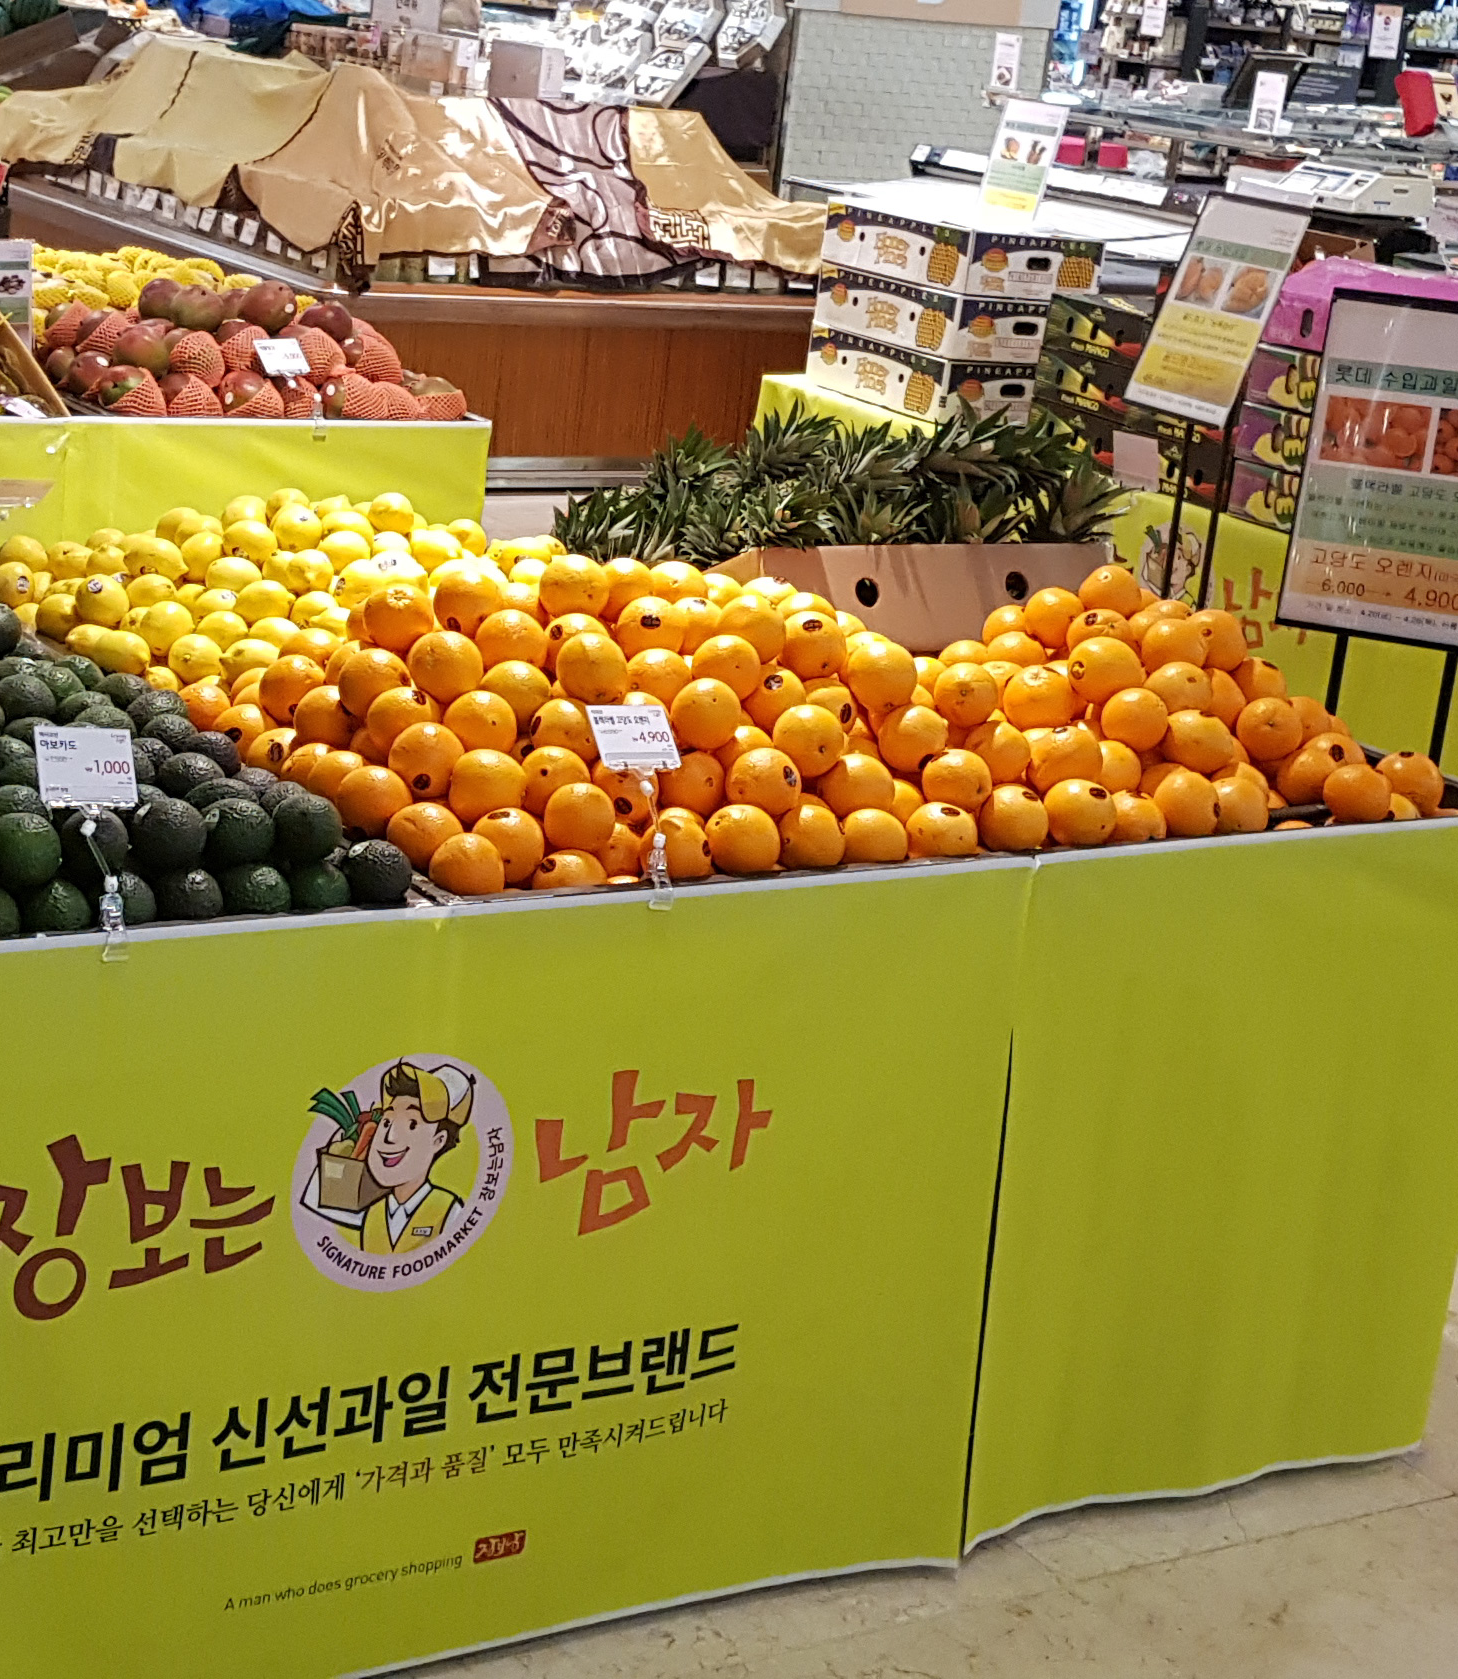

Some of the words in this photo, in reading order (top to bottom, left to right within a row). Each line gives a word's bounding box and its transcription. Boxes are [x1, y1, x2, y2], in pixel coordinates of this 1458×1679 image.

[991, 235, 1087, 251] PINEAPPLES
[978, 302, 1046, 317] PINEAPP
[966, 365, 1033, 376] PINEAPP
[1335, 364, 1373, 385] 롯데
[1311, 547, 1367, 571] 고당도
[535, 1070, 773, 1236] 남자
[316, 1235, 388, 1280] SIGNATURE
[392, 1206, 484, 1279] FOODMARKET
[212, 1365, 450, 1474] 신선과일
[468, 1323, 740, 1424] 전문브랜드
[12, 1514, 123, 1556] 최고만을
[132, 1497, 239, 1536] 선택하는
[247, 1473, 345, 1518] 당신에게
[502, 1438, 551, 1468] 모두
[558, 1398, 729, 1459] 만족시켜드립니다
[224, 1598, 235, 1612] A
[239, 1593, 271, 1609] man
[275, 1585, 305, 1602] who
[308, 1575, 341, 1596] does
[344, 1567, 399, 1591] grocery
[401, 1555, 463, 1578] shopping
